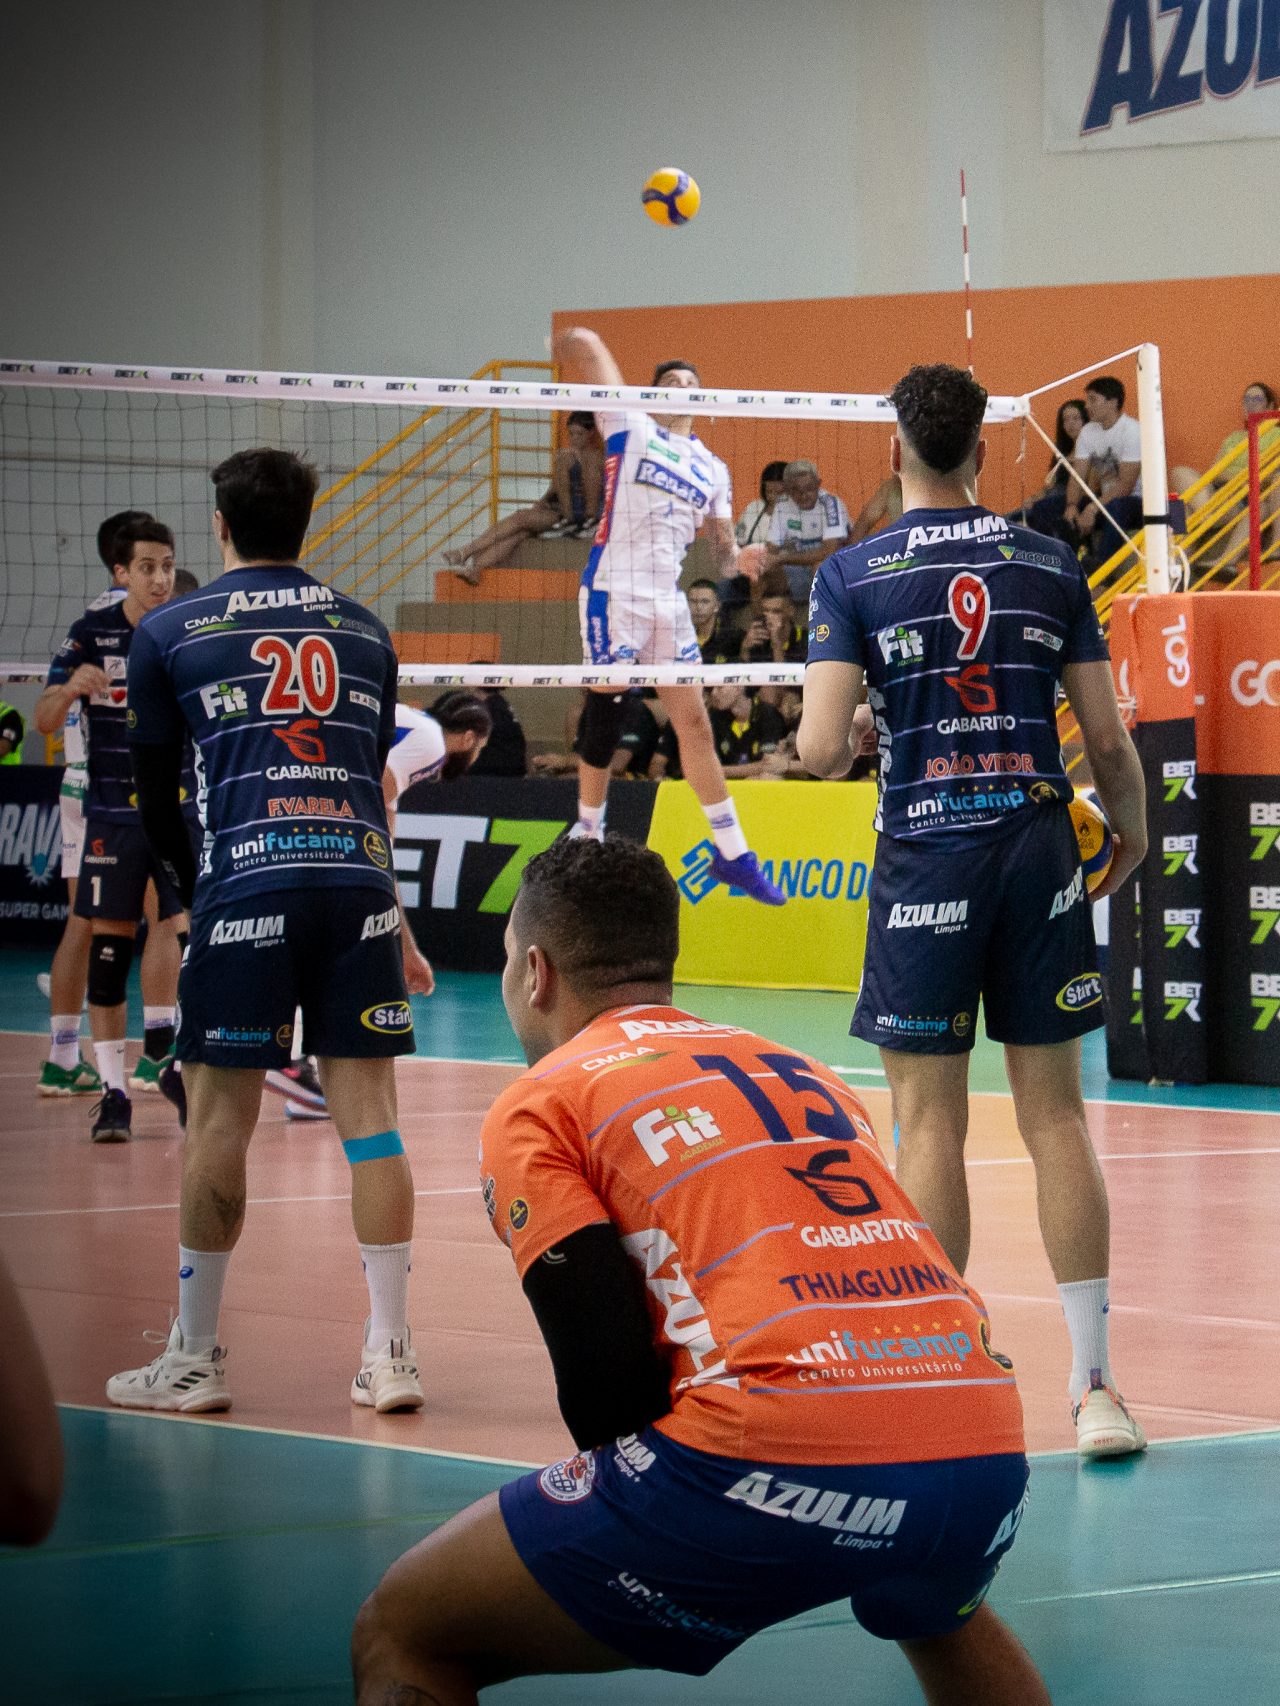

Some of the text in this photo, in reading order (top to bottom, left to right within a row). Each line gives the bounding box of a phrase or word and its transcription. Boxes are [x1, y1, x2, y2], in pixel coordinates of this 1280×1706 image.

[907, 515, 1009, 550] AZULIM
[977, 533, 1006, 543] Limpa
[867, 551, 914, 567] CMAA
[226, 586, 335, 614] AZULIM
[303, 603, 332, 612] Limpa
[184, 613, 235, 630] CMAA
[948, 571, 990, 660] 9
[877, 627, 924, 665] Fit
[1161, 614, 1190, 687] GOL
[250, 635, 339, 716] 20
[199, 684, 247, 719] Fit
[936, 715, 1016, 735] GABARITO
[265, 766, 349, 782] GABARITO
[925, 750, 1035, 780] JOÃO VITOR
[1163, 760, 1196, 778] BET
[1163, 777, 1197, 801] 7K
[267, 797, 355, 818] F.VARELA
[907, 789, 1025, 818] unifucamp
[909, 816, 945, 830] Centro
[231, 831, 356, 859] unifucamp
[1163, 834, 1198, 852] BET
[234, 855, 267, 870] Centro
[1163, 851, 1199, 875] 7K
[90, 876, 102, 907] 1
[728, 858, 873, 901] ANCO D
[887, 899, 968, 929] AZULIM
[1163, 908, 1201, 925] BET
[209, 914, 285, 946] AZULIM
[934, 924, 961, 935] Limpa
[1164, 925, 1201, 948] 7K
[1164, 981, 1201, 999] BET
[373, 1007, 411, 1026] Star
[1163, 998, 1201, 1022] 7K
[206, 1027, 271, 1043] unifucamp
[876, 1014, 948, 1034] unifucamp
[581, 1046, 655, 1071] CMAA
[691, 1053, 857, 1143] 15
[632, 1104, 722, 1168] Fit
[800, 1218, 918, 1247] GABARITO
[779, 1263, 968, 1301] THIAGUINH
[786, 1330, 972, 1364] unifucamp
[798, 1361, 962, 1382] Centro Universitário
[724, 1471, 907, 1536] AZULIM
[833, 1533, 881, 1550] Limpa
